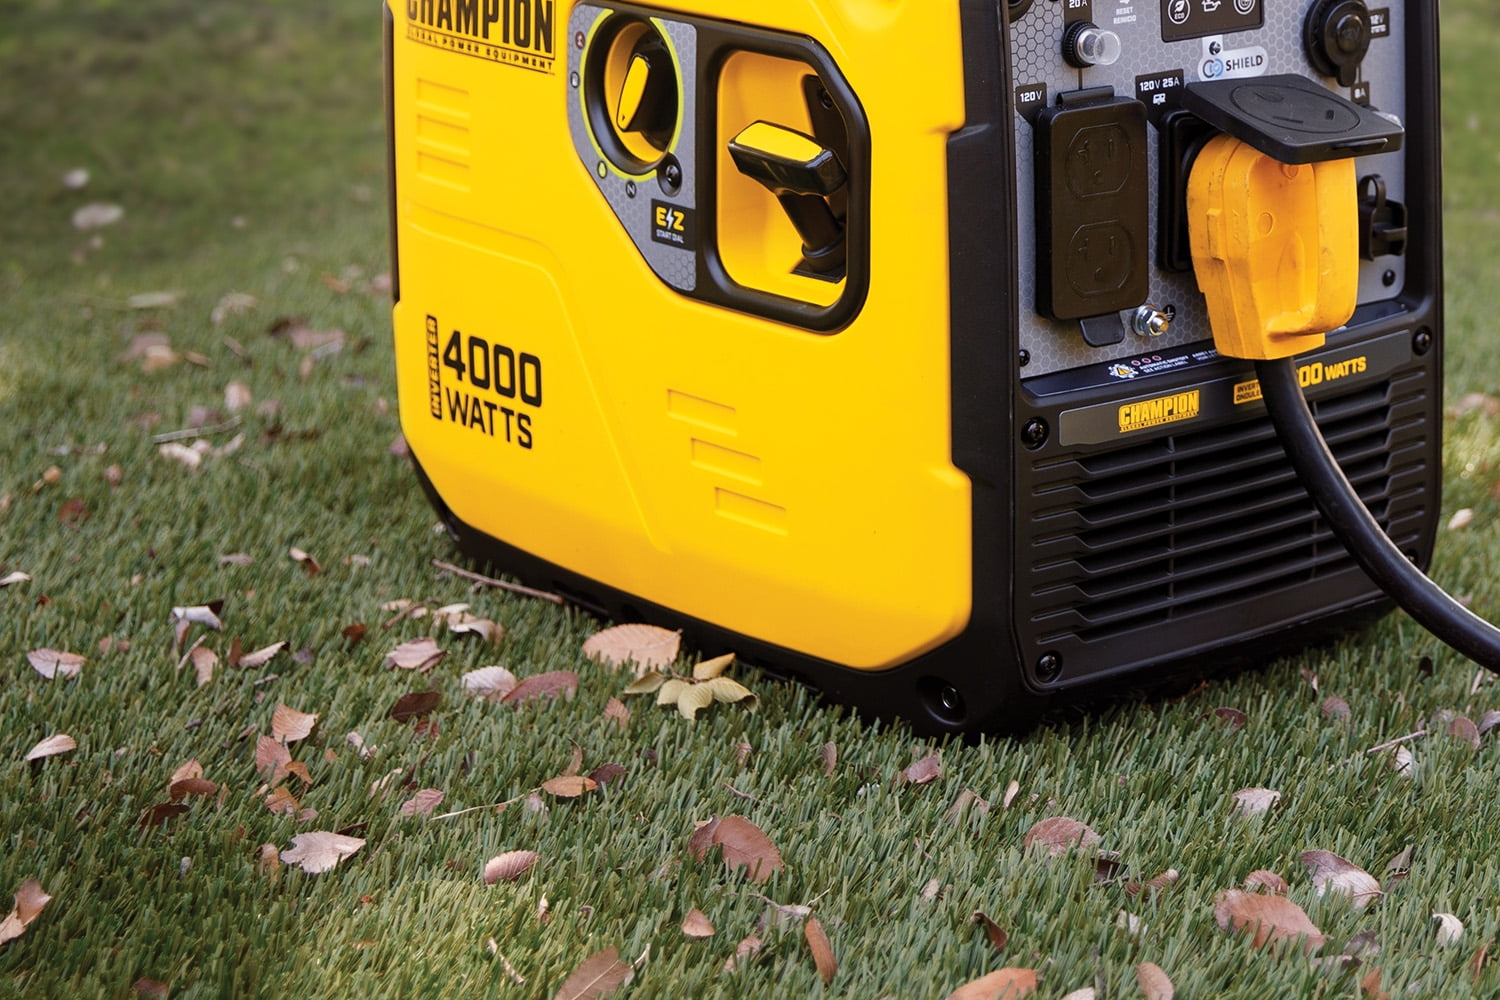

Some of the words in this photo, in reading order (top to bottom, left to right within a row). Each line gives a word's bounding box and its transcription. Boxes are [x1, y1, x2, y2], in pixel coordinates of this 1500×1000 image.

[1115, 6, 1134, 16] RESET
[442, 37, 480, 54] POWER
[486, 46, 553, 71] EQUIPMENT
[1225, 54, 1264, 72] SHIELD
[1019, 90, 1043, 103] 120V
[1138, 78, 1161, 92] 120V
[1162, 76, 1181, 89] 25A
[442, 329, 543, 409] 4000
[1297, 361, 1323, 388] 00
[1324, 355, 1367, 381] WATTS
[446, 385, 533, 450] WATTS
[1120, 392, 1199, 426] CHAMPION
